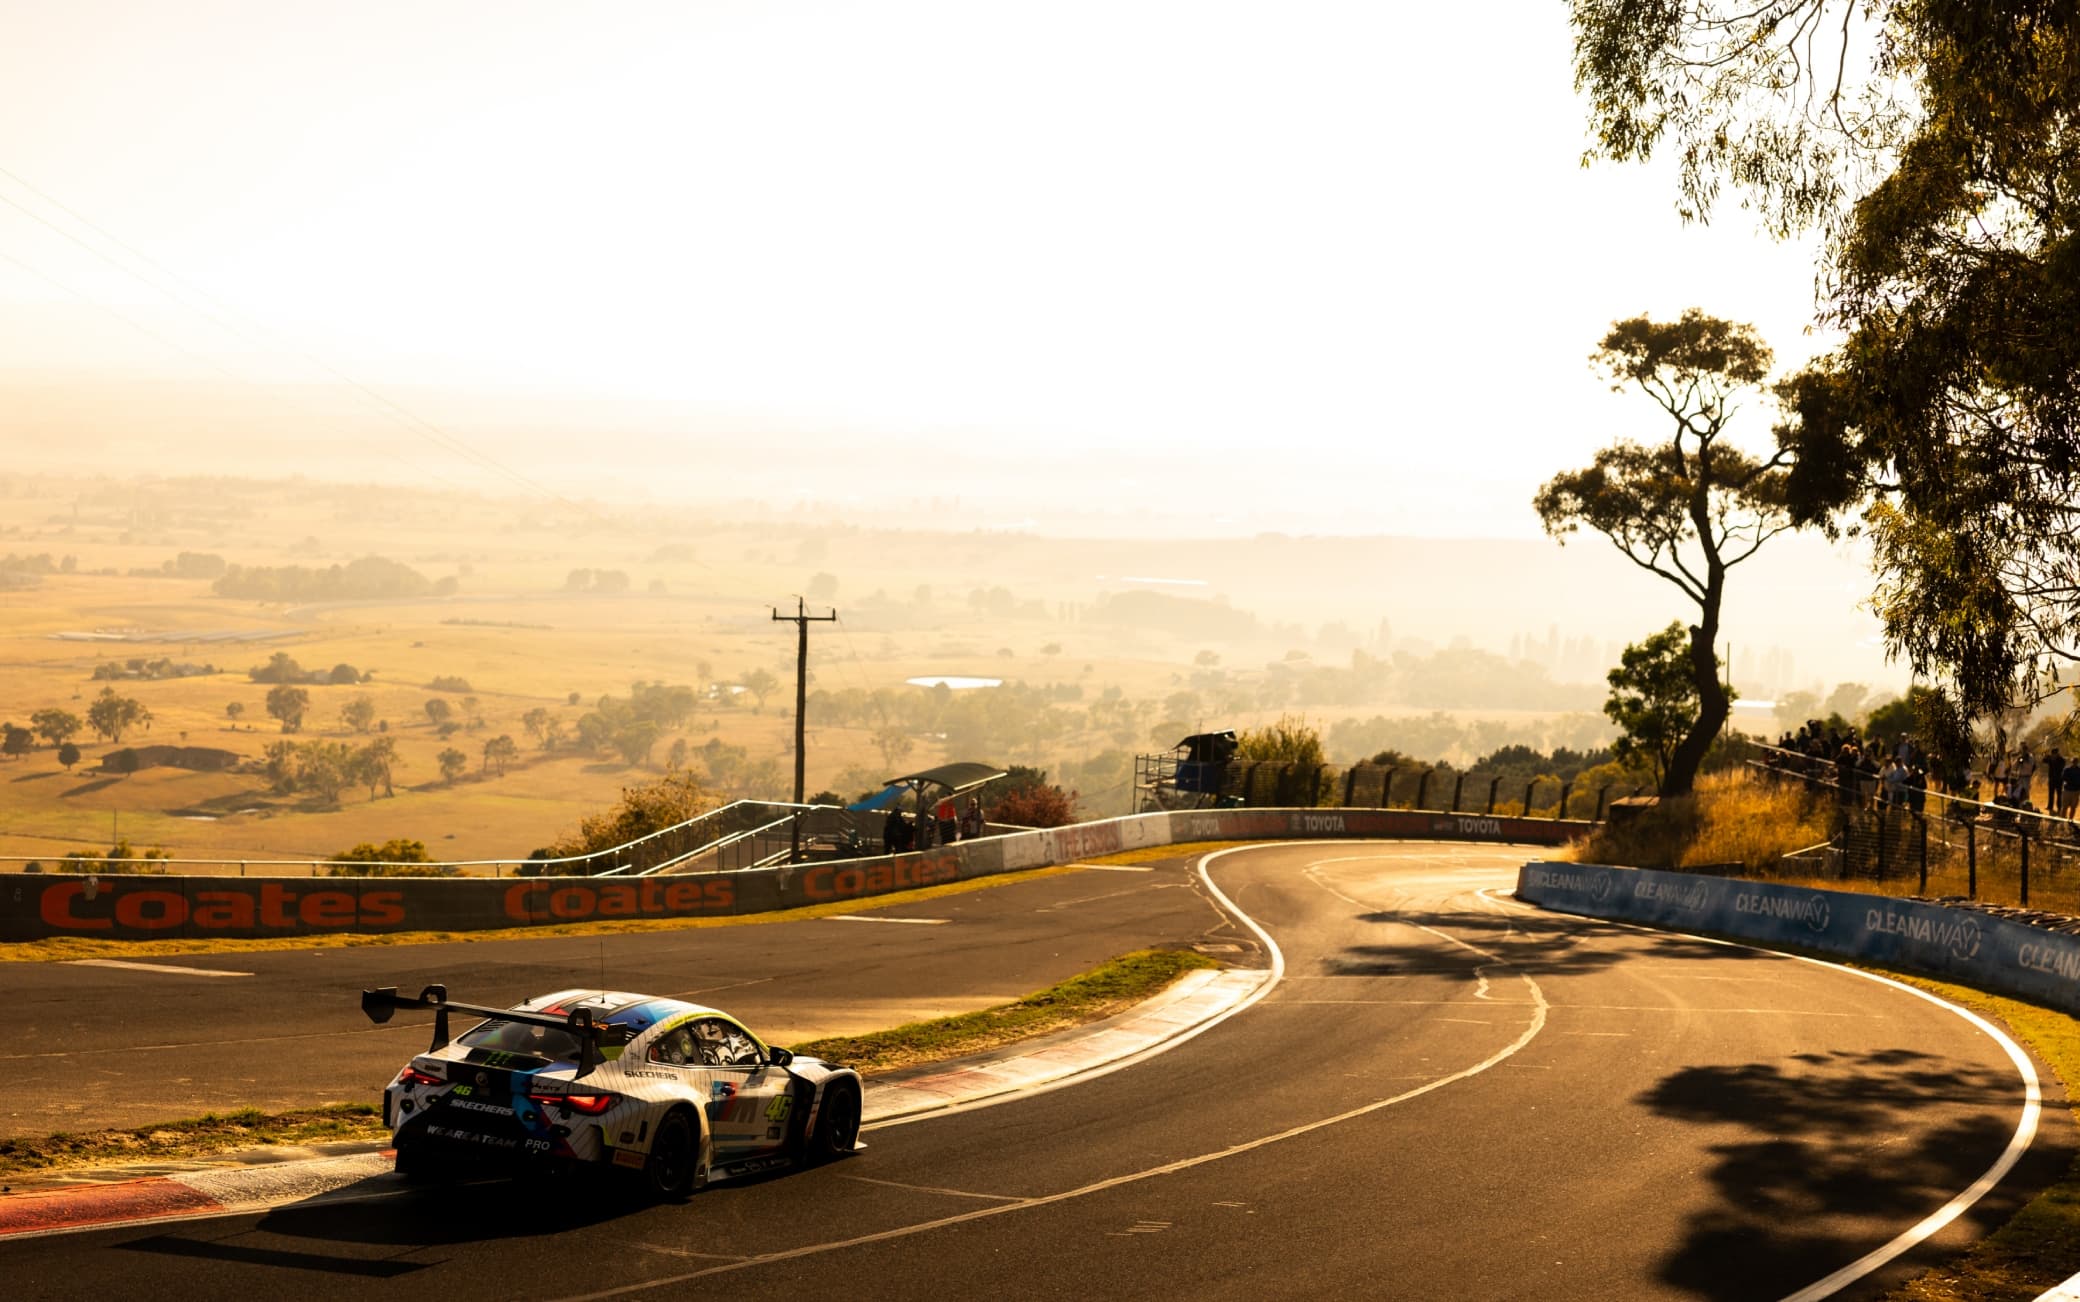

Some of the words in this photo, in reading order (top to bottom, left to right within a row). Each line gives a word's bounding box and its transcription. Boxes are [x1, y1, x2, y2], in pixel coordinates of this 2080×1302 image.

[1191, 818, 1220, 835] TOYOTA
[1305, 816, 1346, 832] TOYOTA
[1457, 818, 1501, 835] TOYOTA
[803, 853, 959, 899] Coates
[40, 881, 406, 930] Coates
[504, 879, 735, 921] Coates
[1735, 892, 1824, 924] CLEANAWAY
[1865, 909, 1976, 950] CLEANAWAY
[2018, 943, 2080, 981] CLEAN
[624, 1070, 678, 1081] SKECHERS
[452, 1084, 473, 1096] 46
[449, 1098, 515, 1116] SKECHERS
[764, 1094, 793, 1122] 46
[524, 1138, 551, 1151] PRO
